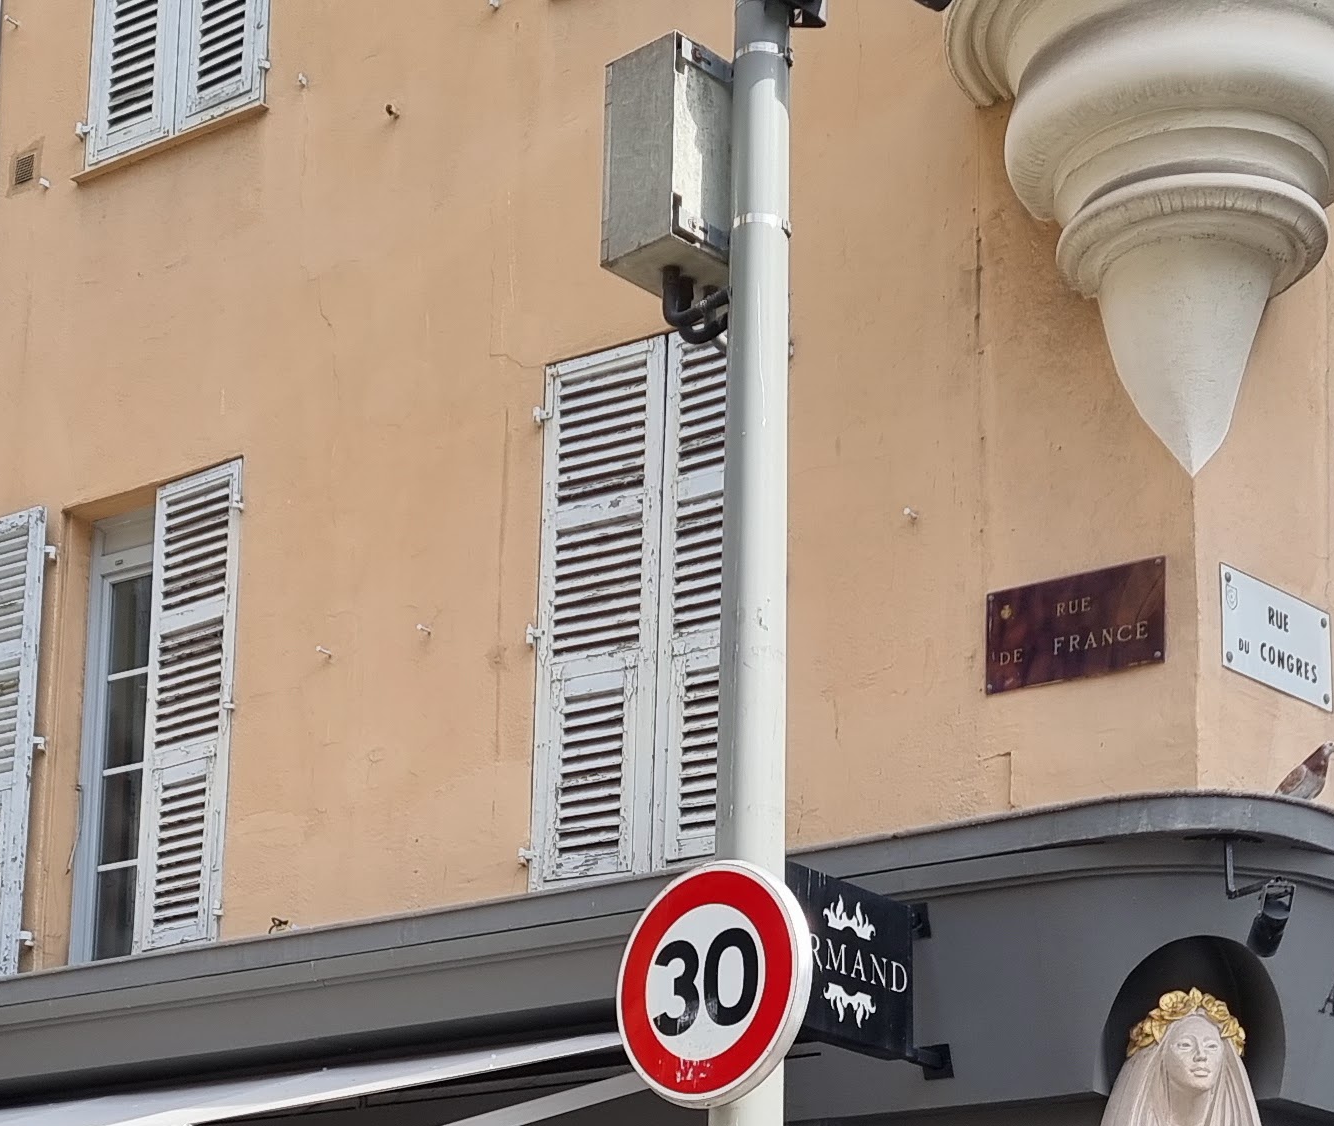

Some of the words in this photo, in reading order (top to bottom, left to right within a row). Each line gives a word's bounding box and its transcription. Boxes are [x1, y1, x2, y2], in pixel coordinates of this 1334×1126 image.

[1056, 597, 1091, 617] RUE
[1268, 606, 1289, 633] RUE
[999, 649, 1023, 666] DE
[1053, 621, 1149, 655] FRANCE
[1238, 638, 1250, 654] DU
[1260, 642, 1318, 684] CONGRES
[653, 927, 759, 1036] 30
[810, 933, 907, 993] RMAND
